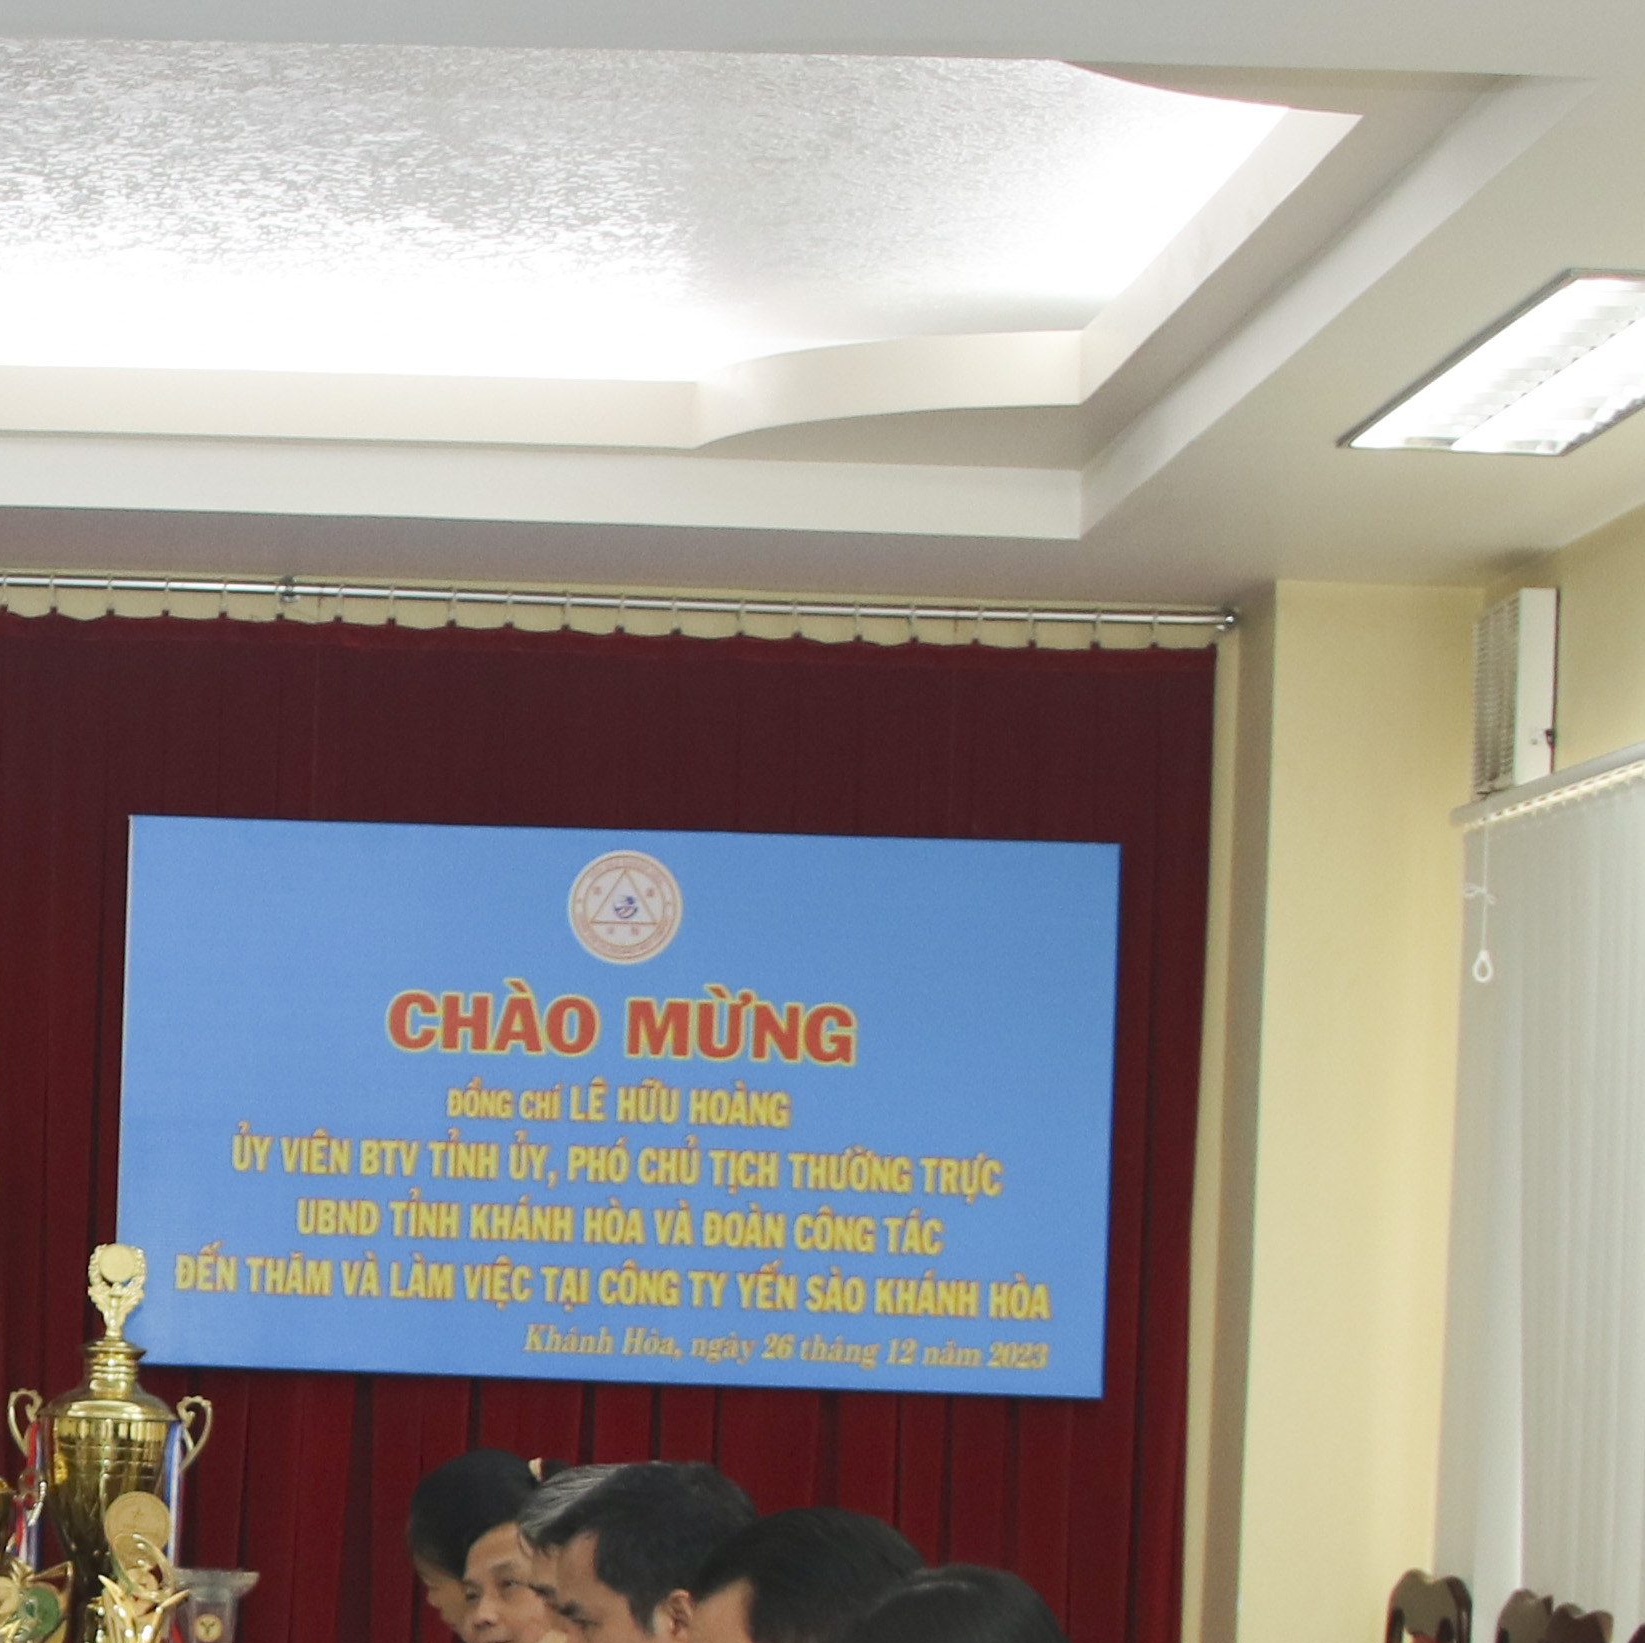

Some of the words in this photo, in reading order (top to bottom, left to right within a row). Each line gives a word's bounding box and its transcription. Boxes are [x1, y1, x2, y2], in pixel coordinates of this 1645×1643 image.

[387, 978, 597, 1057] CHÀO
[624, 983, 856, 1065] MỪNG
[447, 1077, 513, 1119] ĐỒNG
[519, 1083, 562, 1121] CHÍ
[570, 1077, 607, 1122] LÊ
[616, 1078, 679, 1125] HỮU
[688, 1081, 791, 1128] HOÀNG
[231, 1120, 272, 1172] ỦY
[280, 1128, 351, 1175] VIÊN
[359, 1139, 419, 1177] BTV
[428, 1127, 499, 1179] TỈNH
[509, 1129, 558, 1189] ỦY,
[567, 1136, 630, 1183] PHÓ
[637, 1134, 699, 1184] CHỦ
[708, 1148, 779, 1195] TỊCH
[788, 1144, 912, 1194] THƯỜNG
[919, 1152, 1003, 1204] TRỰC
[296, 1198, 380, 1237] UBND
[389, 1187, 460, 1239] TỈNH
[469, 1195, 574, 1242] KHÁNH
[583, 1197, 645, 1245] HÒA
[654, 1198, 694, 1246] VÀ
[702, 1202, 786, 1249] ĐOÀN
[793, 1205, 876, 1253] CÔNG
[883, 1207, 944, 1255] TÁC
[174, 1241, 237, 1293] ĐẾN
[246, 1251, 333, 1297] THĂM
[340, 1250, 380, 1297] VÀ
[389, 1252, 455, 1300] LÀM
[463, 1255, 532, 1310] VIỆC
[540, 1266, 590, 1312] TẠI
[598, 1258, 681, 1307] CÔNG
[688, 1270, 728, 1309] TY
[736, 1259, 798, 1311] YẾN
[805, 1265, 867, 1313] SÀO
[875, 1269, 979, 1318] KHÁNH
[987, 1273, 1051, 1320] HÒA
[523, 1323, 614, 1355] Khánh
[621, 1326, 682, 1361] Hòa,
[690, 1331, 756, 1365] ngày
[761, 1333, 794, 1360] 26
[800, 1335, 880, 1370] tháng
[886, 1337, 916, 1366] 12
[922, 1339, 982, 1368] năm
[987, 1341, 1049, 1370] 2023
